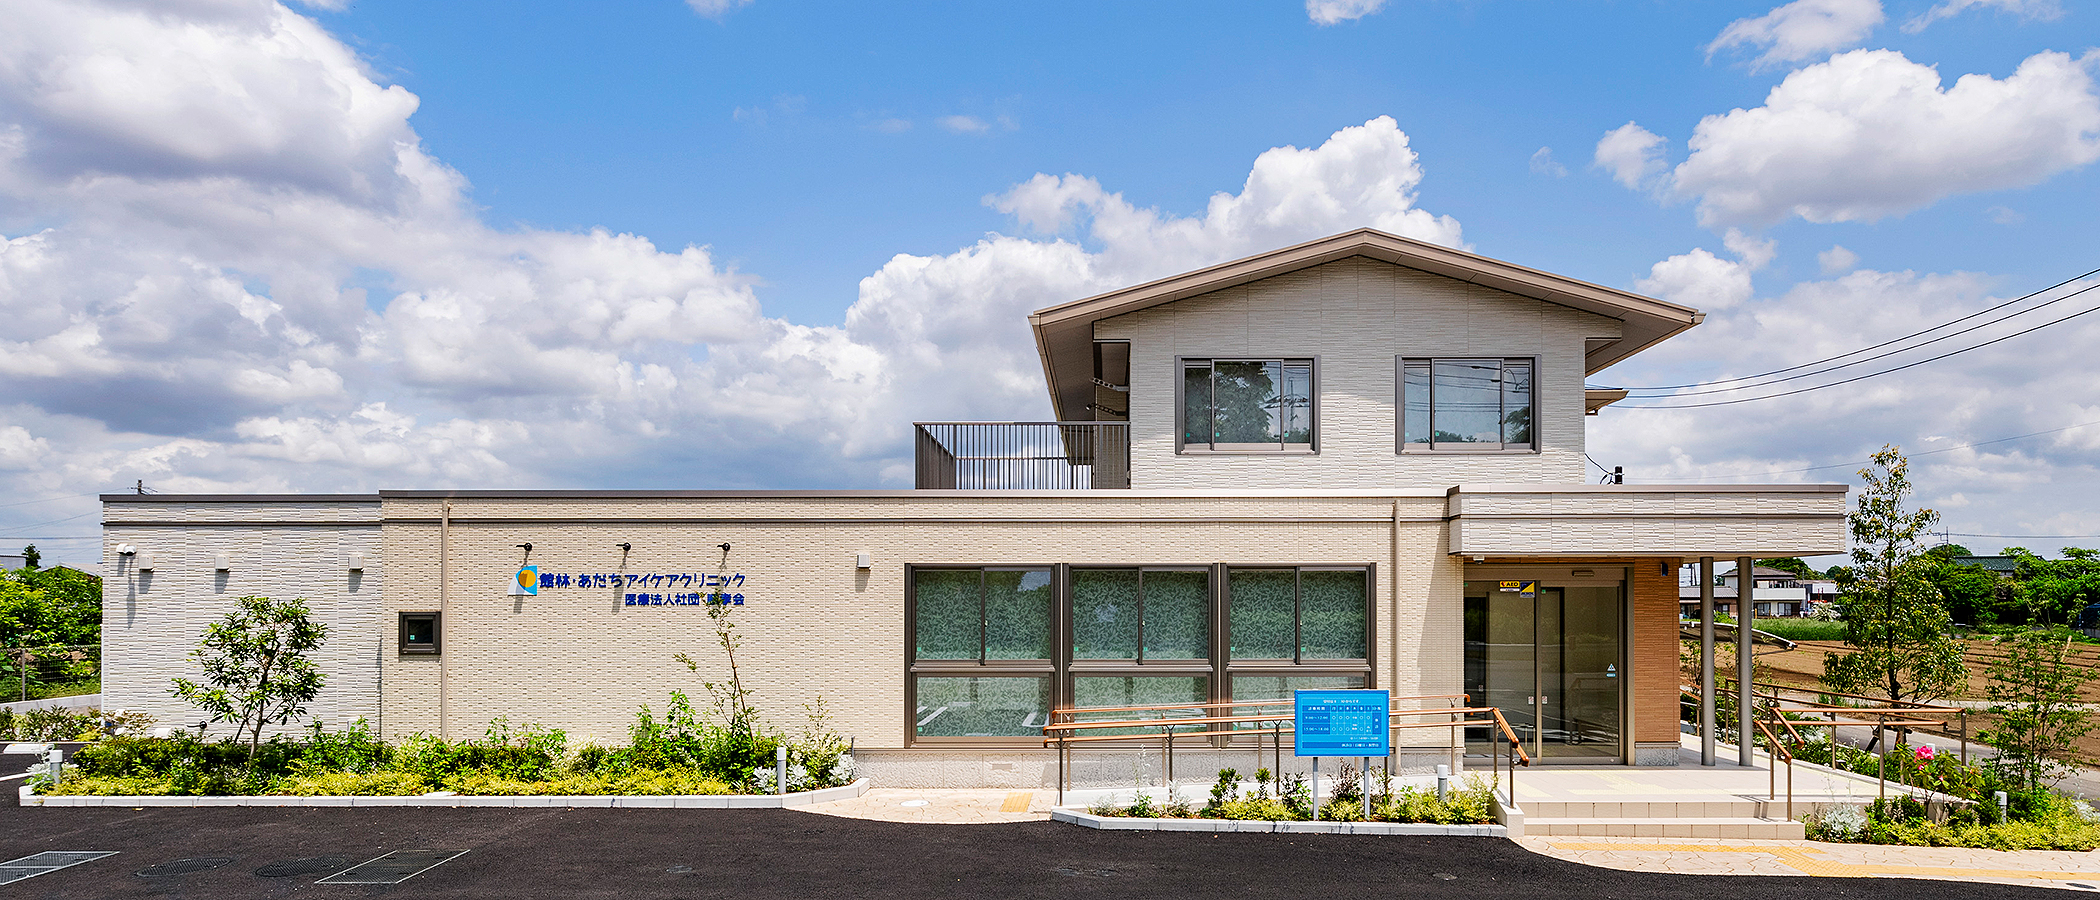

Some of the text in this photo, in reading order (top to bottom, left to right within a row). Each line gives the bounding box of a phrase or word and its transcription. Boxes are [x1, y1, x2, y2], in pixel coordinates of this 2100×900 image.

[539, 573, 745, 588] 館林・あだちアイケアクリニック
[624, 593, 700, 606] 医療法人社団
